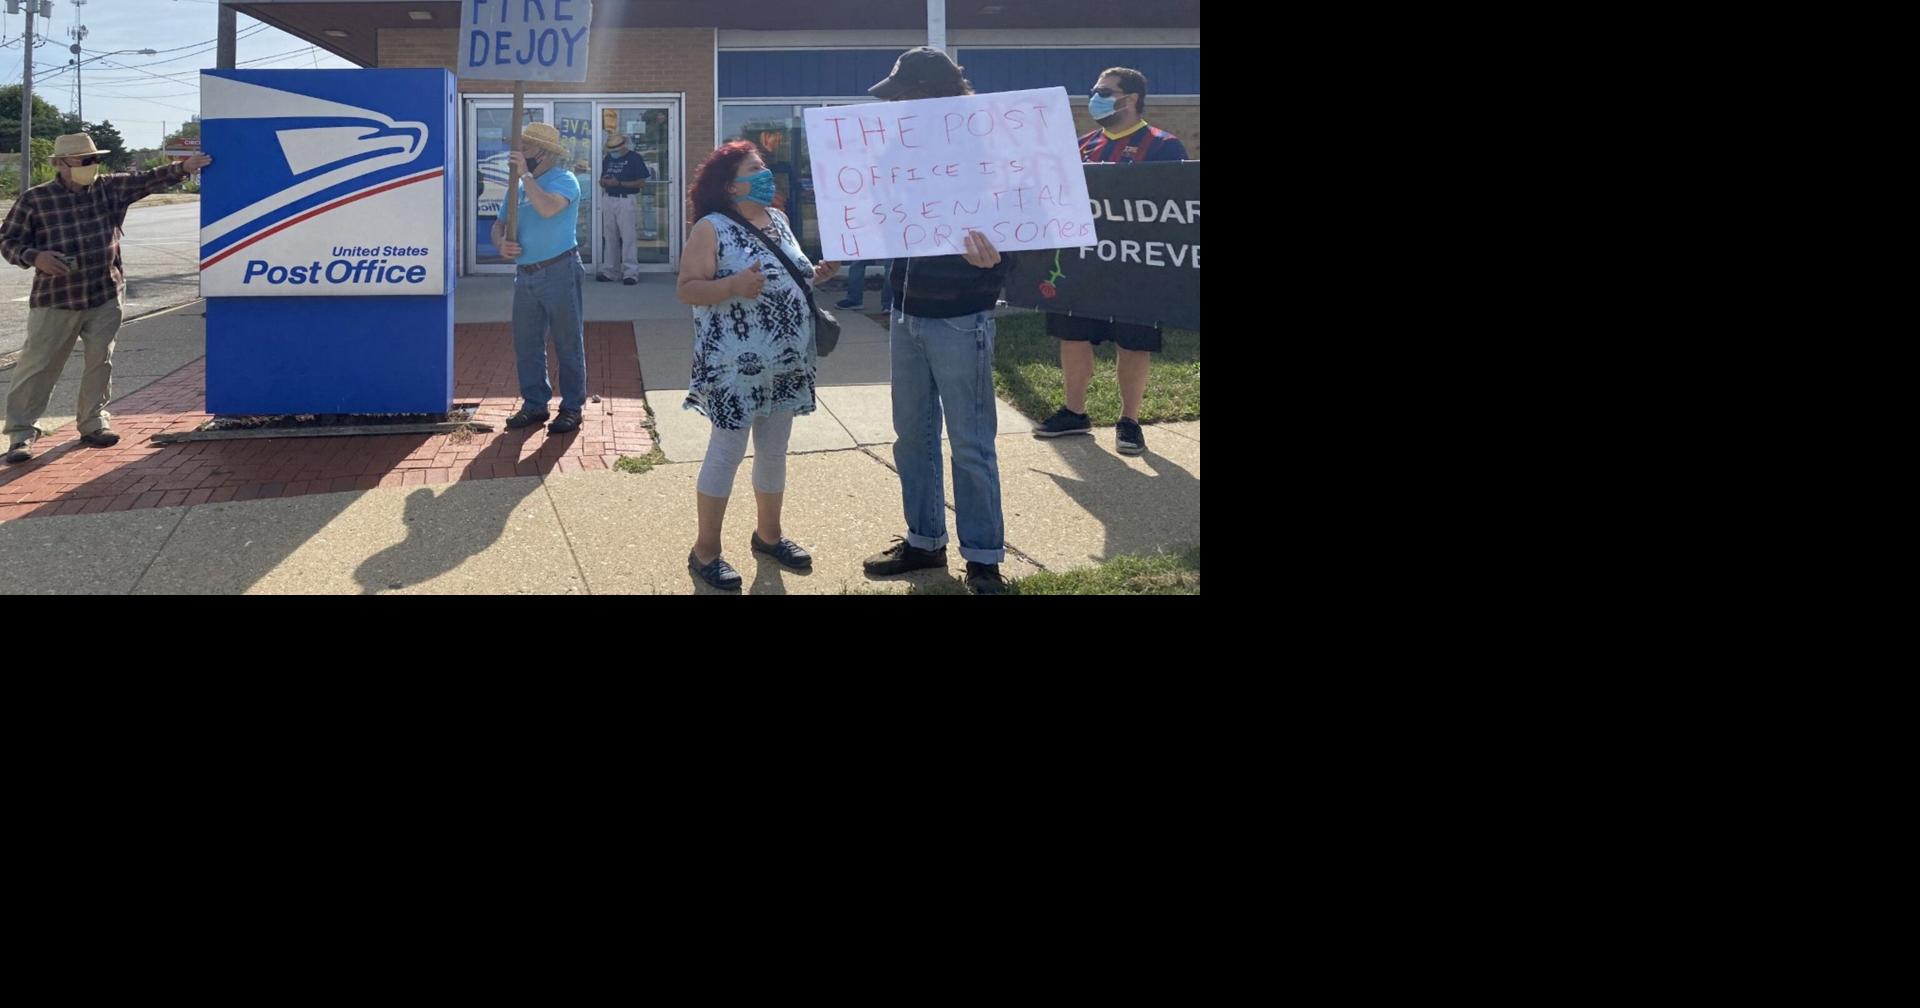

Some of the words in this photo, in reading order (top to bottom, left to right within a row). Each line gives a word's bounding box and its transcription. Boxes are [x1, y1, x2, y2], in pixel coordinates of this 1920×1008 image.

[469, 26, 588, 67] DEJOY
[825, 115, 921, 150] THE
[944, 105, 1050, 145] POST
[838, 163, 959, 194] OFFICE
[979, 160, 1025, 175] IS
[844, 184, 1074, 229] ESSENTIAL
[332, 246, 379, 257] United
[382, 246, 429, 257] States
[243, 260, 322, 285] Post
[325, 259, 427, 284] Office
